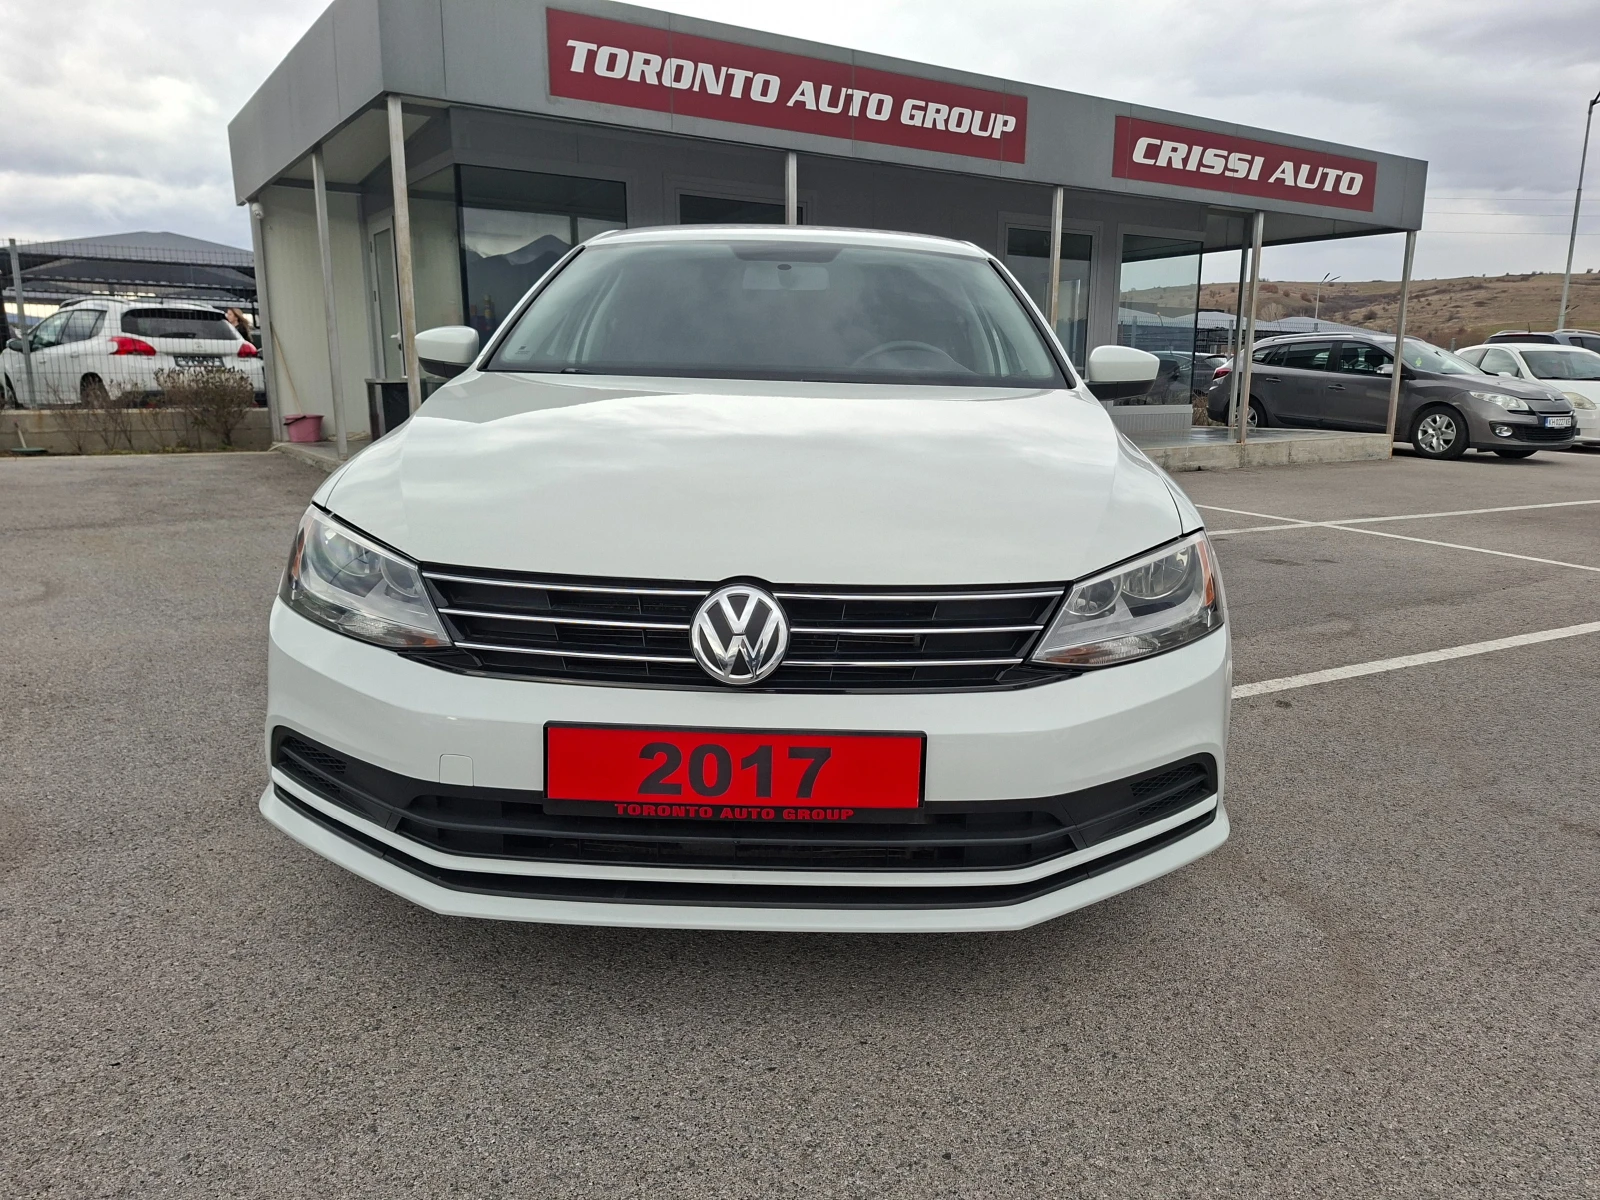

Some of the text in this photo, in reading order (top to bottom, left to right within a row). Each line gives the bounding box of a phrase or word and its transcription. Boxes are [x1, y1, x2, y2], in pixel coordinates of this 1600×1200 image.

[566, 39, 1017, 139] TORONTO AUTO GROUP
[1132, 136, 1364, 196] CRISSI AUTO
[691, 585, 788, 685] VW
[637, 741, 832, 799] 2017
[614, 803, 854, 821] TORONTO AUTO GROUP
